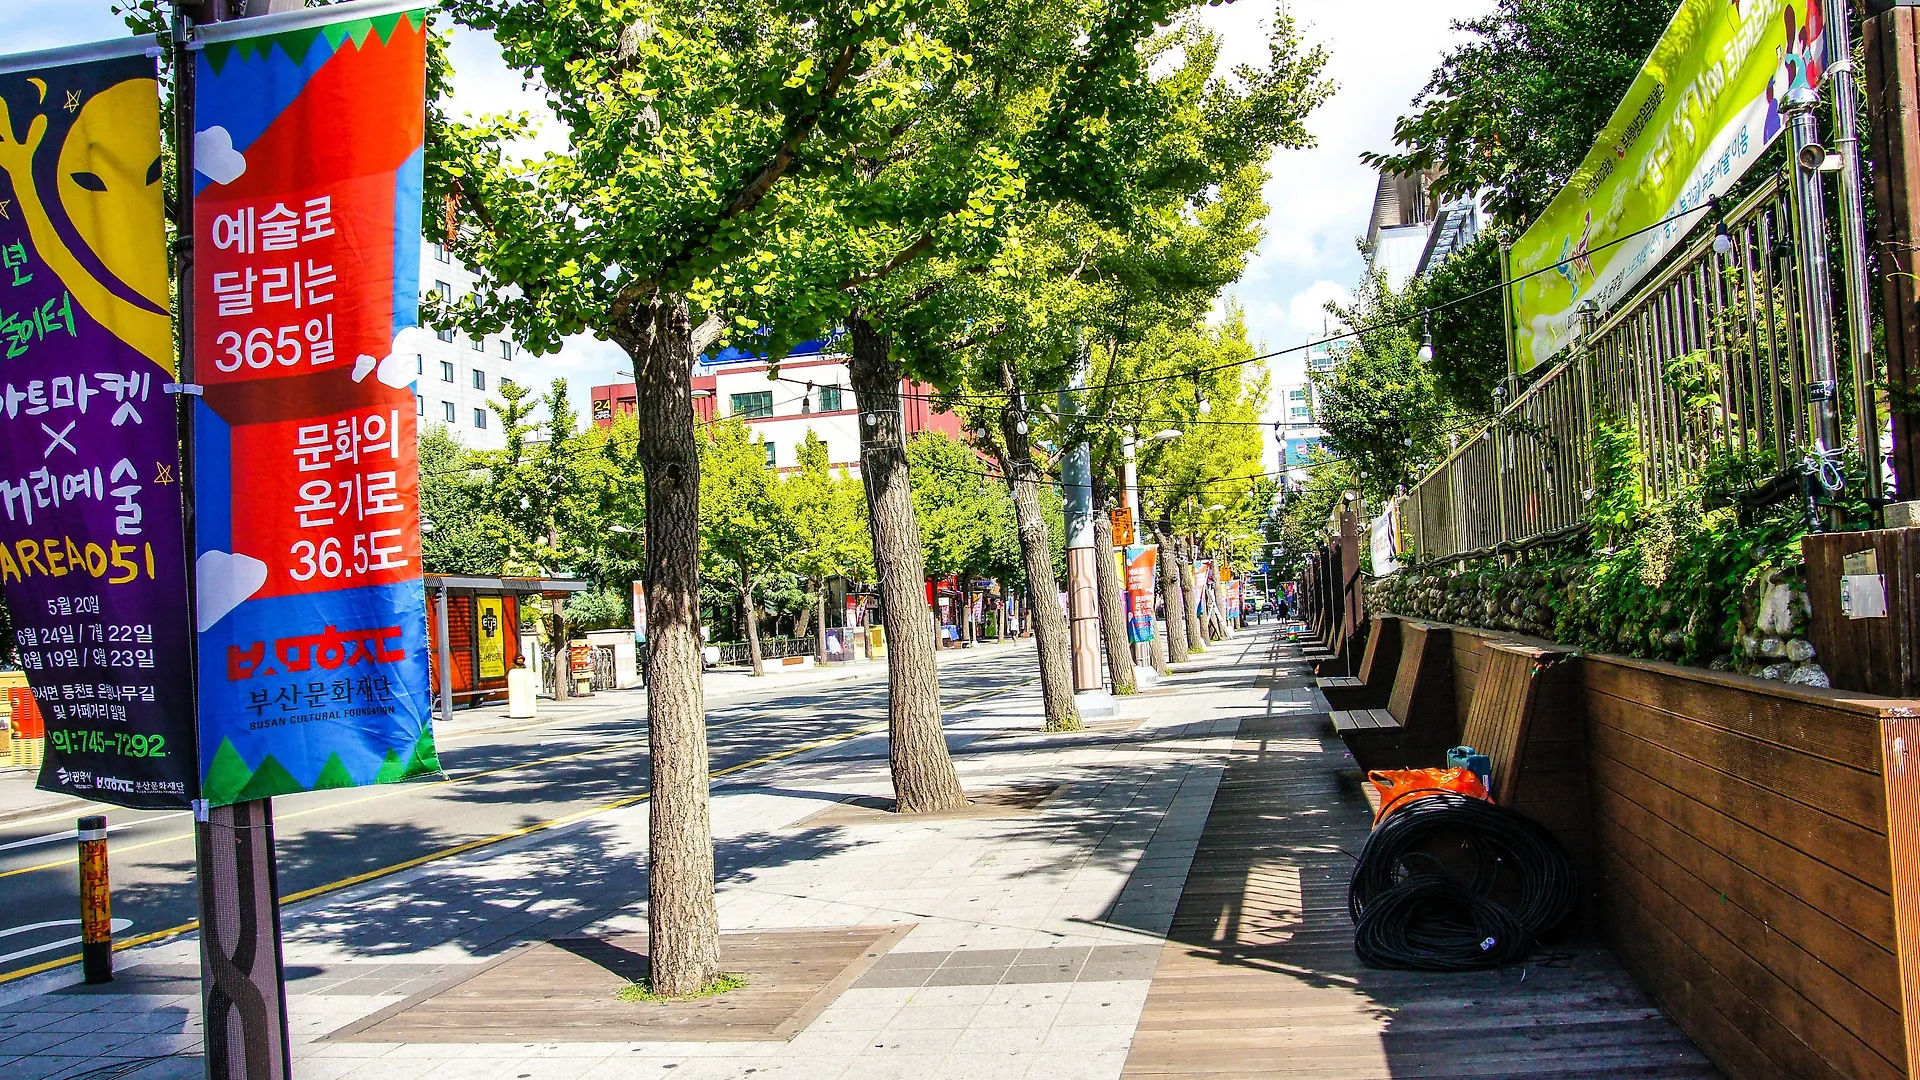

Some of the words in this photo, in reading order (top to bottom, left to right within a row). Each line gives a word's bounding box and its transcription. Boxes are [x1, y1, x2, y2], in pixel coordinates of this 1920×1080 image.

[212, 195, 335, 254] 예술로
[213, 259, 337, 316] 달리는
[215, 314, 335, 372] 365일
[594, 400, 611, 411] 24
[293, 409, 399, 472] 문화의
[0, 458, 142, 535] 거리예술
[294, 471, 404, 528] 온기로
[289, 528, 409, 581] 36.5도
[48, 597, 72, 615] 5월
[74, 595, 100, 614] 20일
[17, 627, 38, 646] 6월
[41, 625, 75, 644] 24일
[88, 623, 104, 643] 7월
[108, 624, 153, 643] 22일
[23, 651, 44, 669] 8월
[47, 649, 79, 667] 19일
[93, 648, 107, 667] 9월
[111, 649, 155, 668] 23일
[62, 684, 95, 699] 동천로
[246, 675, 393, 716] 부산문화재단
[54, 705, 67, 719] 및
[70, 703, 109, 719] 카페거리
[110, 704, 127, 721] 일원
[250, 717, 286, 731] BUSAN
[290, 712, 341, 724] CULTURAL
[344, 706, 395, 717] FOUNDATION
[47, 729, 165, 757] 의:745-7292
